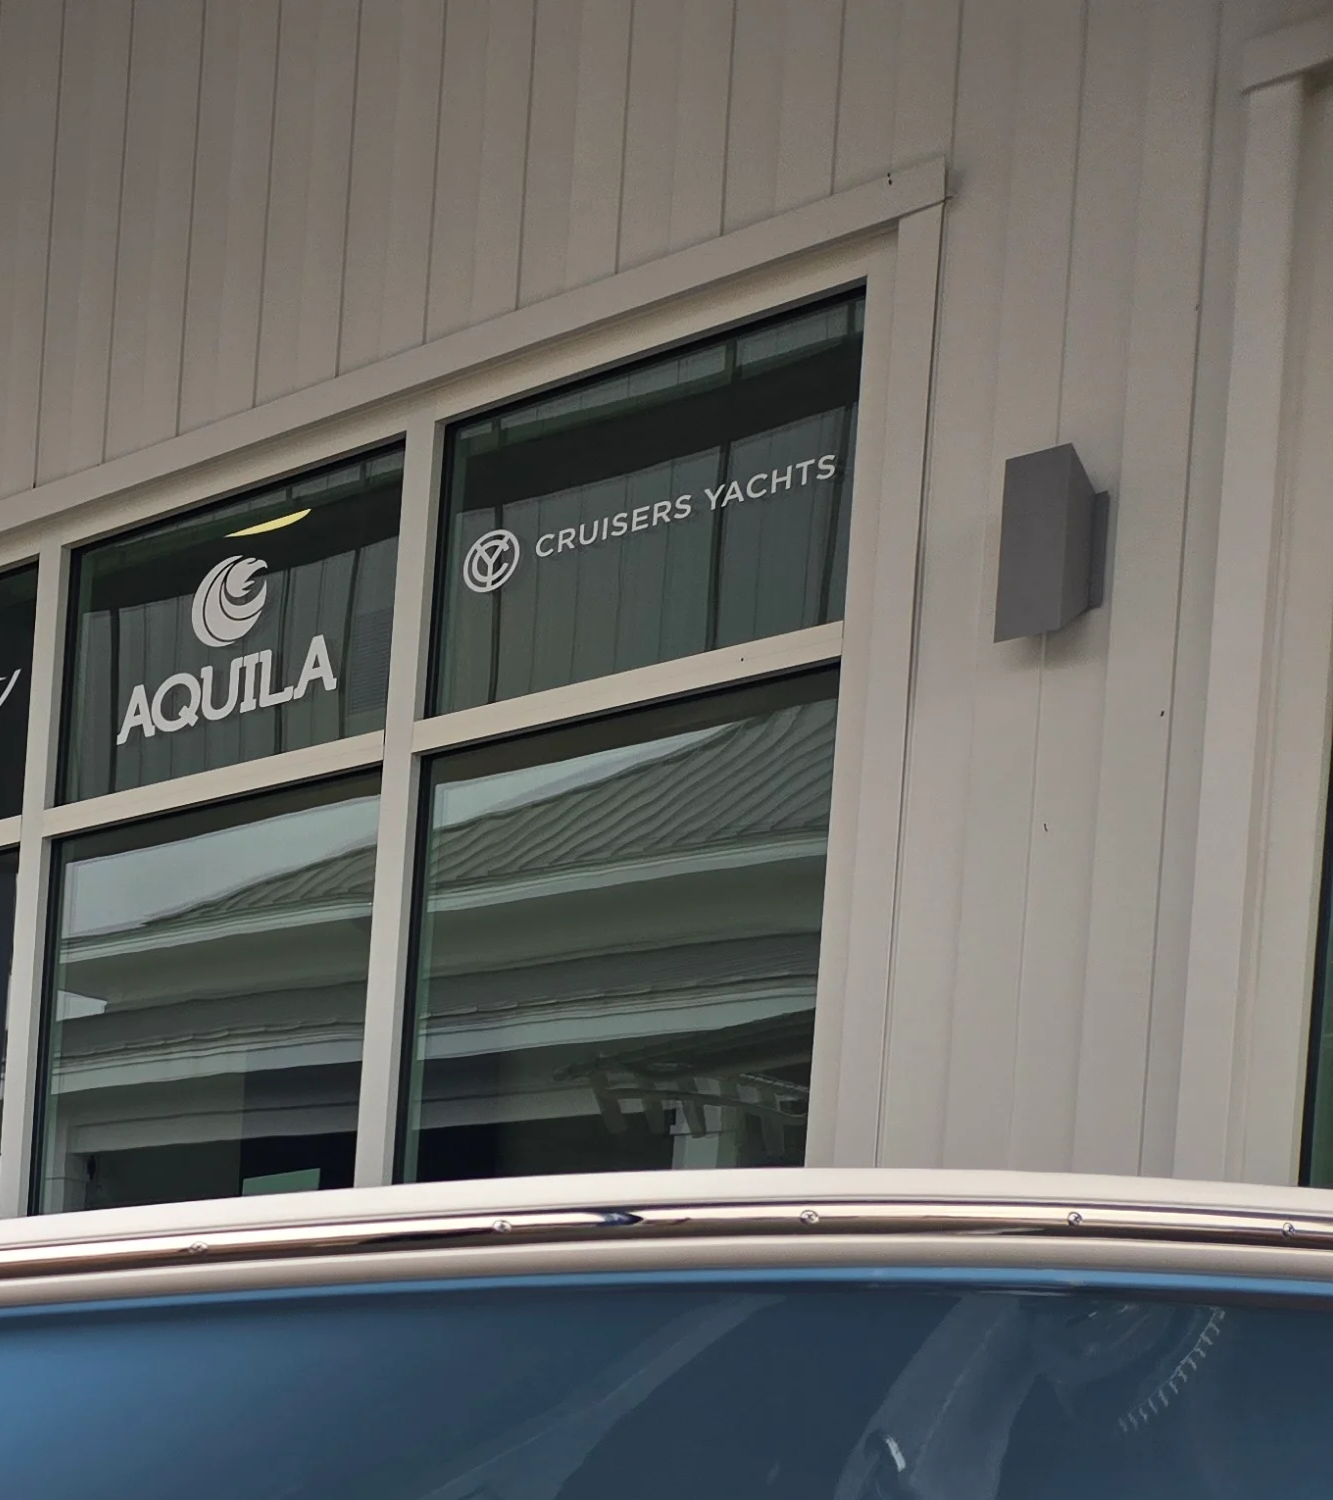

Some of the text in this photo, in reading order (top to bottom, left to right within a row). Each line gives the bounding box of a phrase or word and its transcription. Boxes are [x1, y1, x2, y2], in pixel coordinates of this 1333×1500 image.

[535, 454, 837, 558] CRUISERS YACHTS
[116, 634, 338, 745] AQUILA
